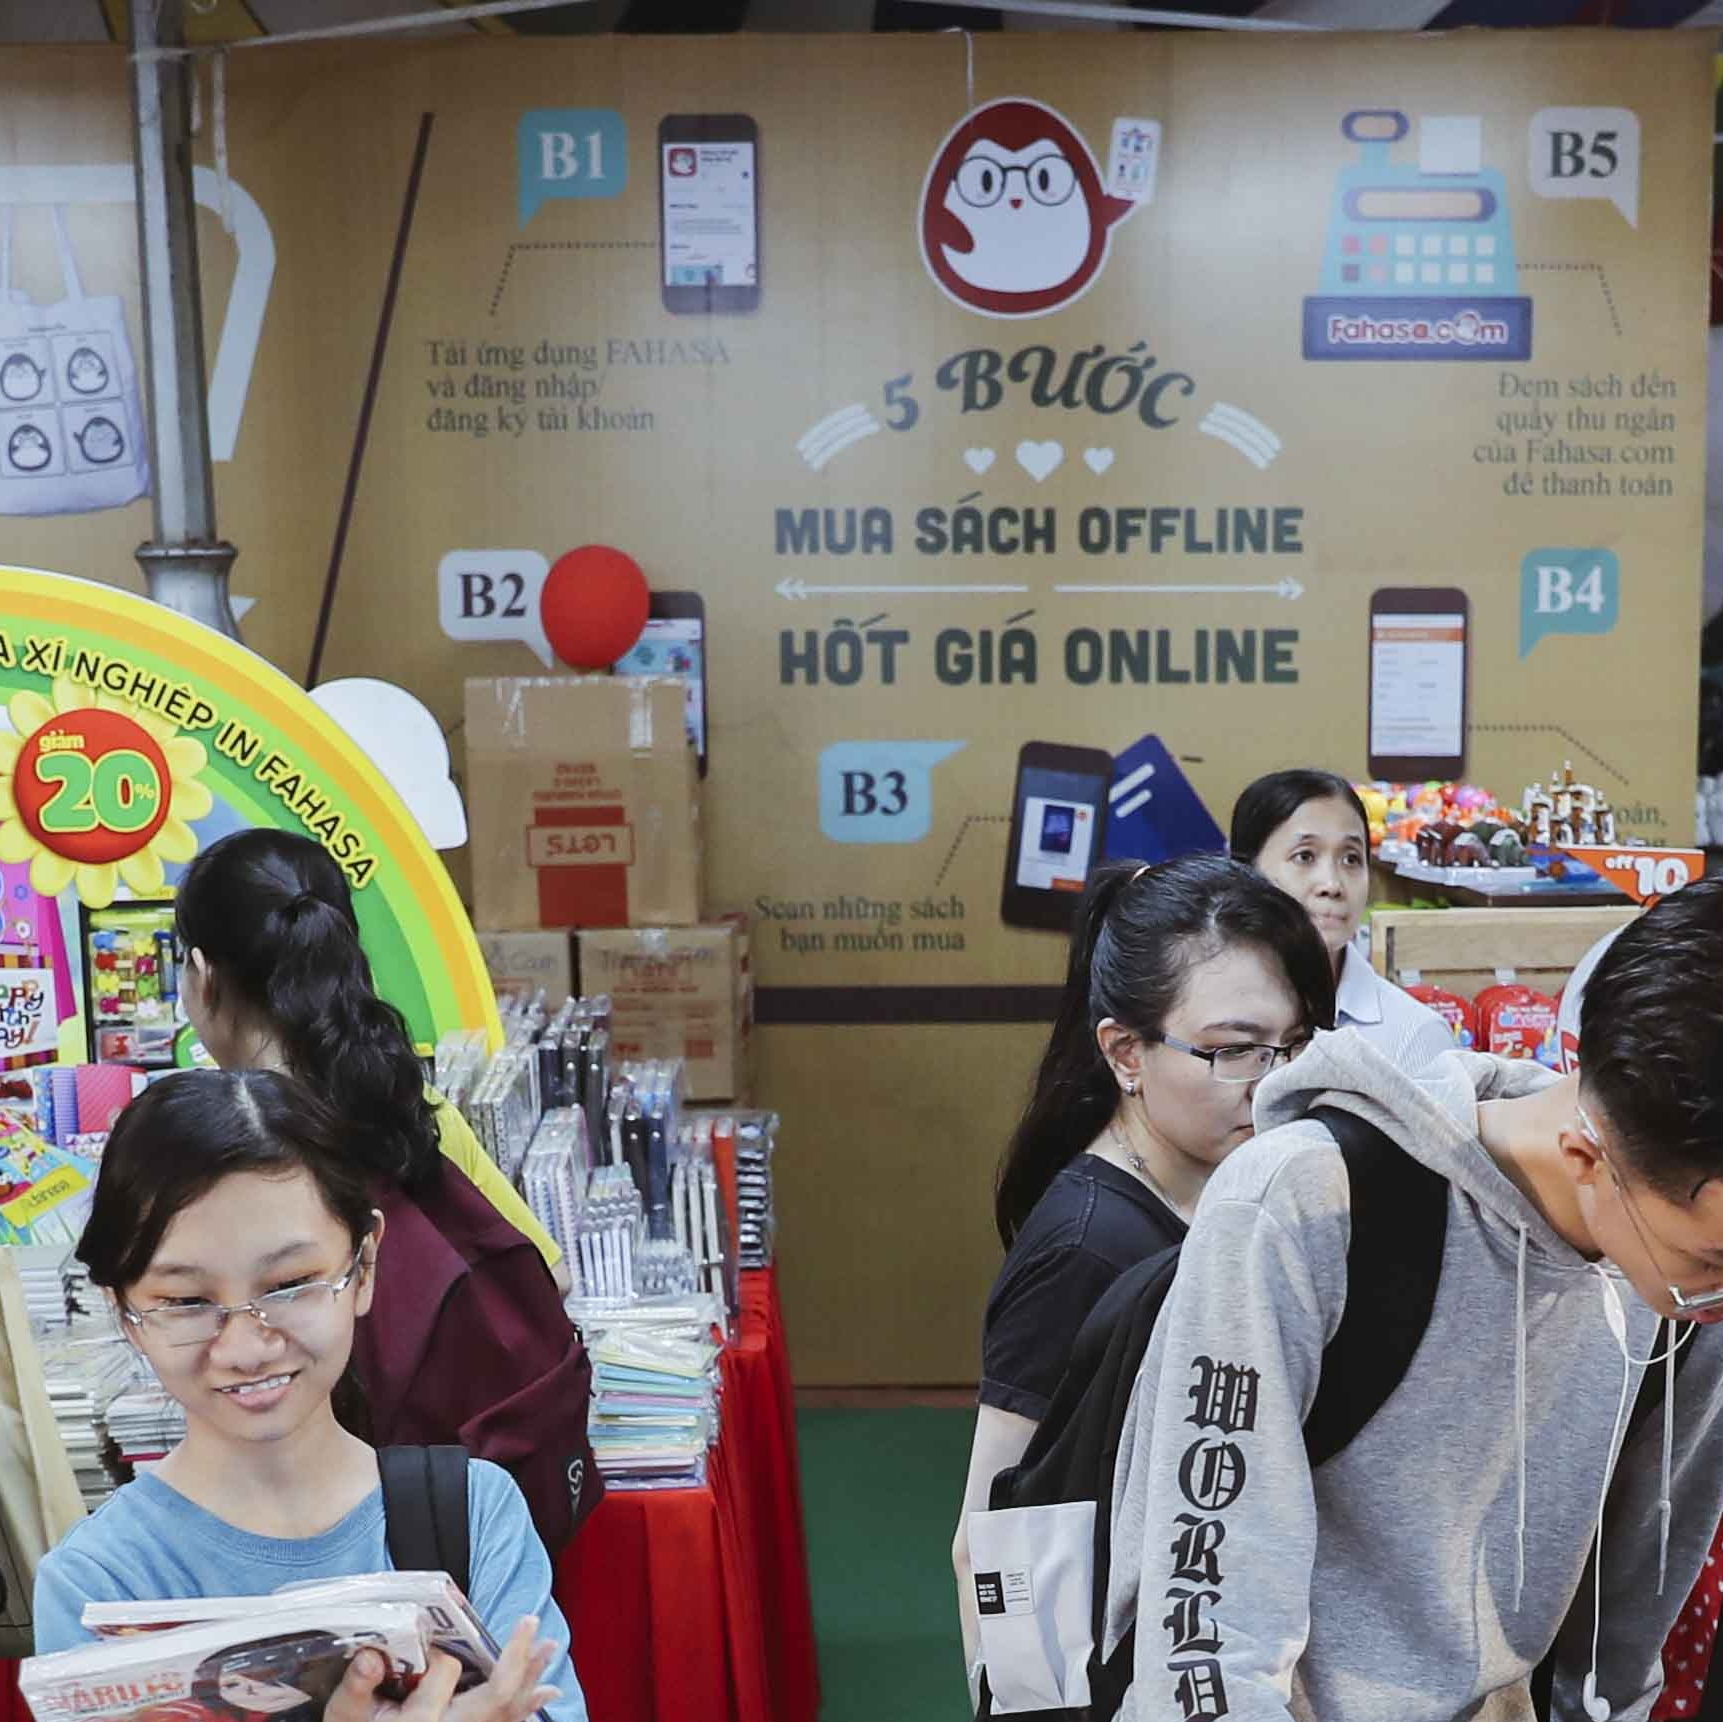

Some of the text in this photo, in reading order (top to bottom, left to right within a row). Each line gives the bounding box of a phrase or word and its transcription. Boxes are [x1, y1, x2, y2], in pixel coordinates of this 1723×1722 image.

[538, 131, 604, 180] B1
[1549, 130, 1618, 178] B5
[883, 373, 921, 432] 5
[774, 490, 1304, 555] MUA SÁCH OFFLINE
[458, 572, 527, 619] B2
[1534, 566, 1605, 614] B4
[780, 608, 1300, 685] HỐT GIÁ ONLINE
[22, 631, 67, 675] XÍ
[69, 645, 219, 737] NGHIỆP
[216, 715, 262, 767] IN
[258, 747, 381, 891] FAHASA
[37, 728, 87, 755] giảm
[839, 770, 909, 817] B3
[1606, 854, 1633, 870] off
[908, 896, 966, 920] sách
[908, 933, 966, 952] mua
